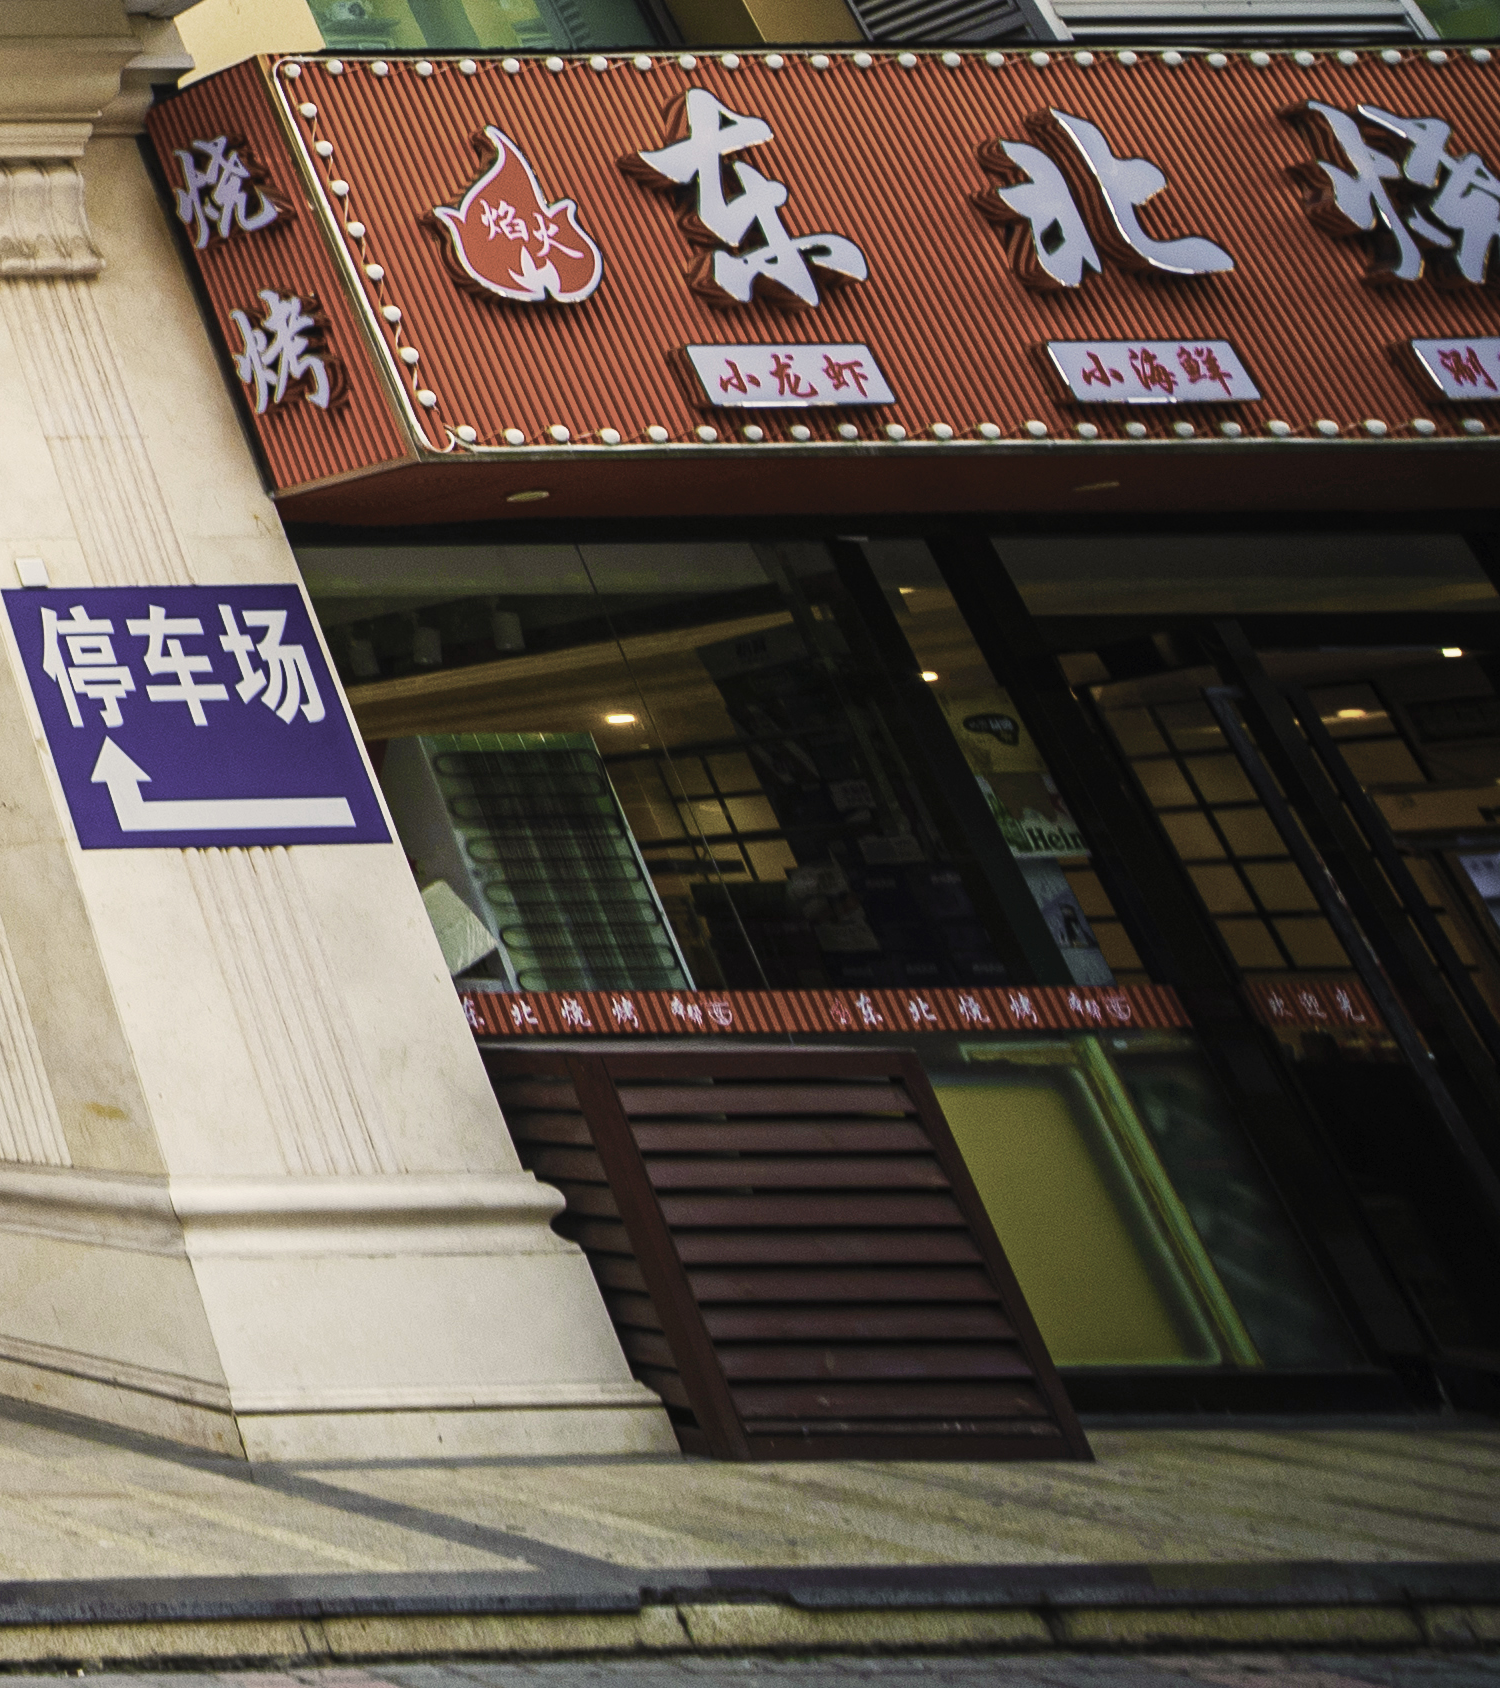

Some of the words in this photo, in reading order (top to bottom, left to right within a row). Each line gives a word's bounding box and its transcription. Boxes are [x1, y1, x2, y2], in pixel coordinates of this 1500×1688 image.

[479, 198, 585, 259] 焰火
[173, 134, 332, 416] 烧烤
[719, 353, 870, 399] 小龙虾
[1081, 346, 1233, 396] 小海鲜
[40, 603, 326, 730] 停车场
